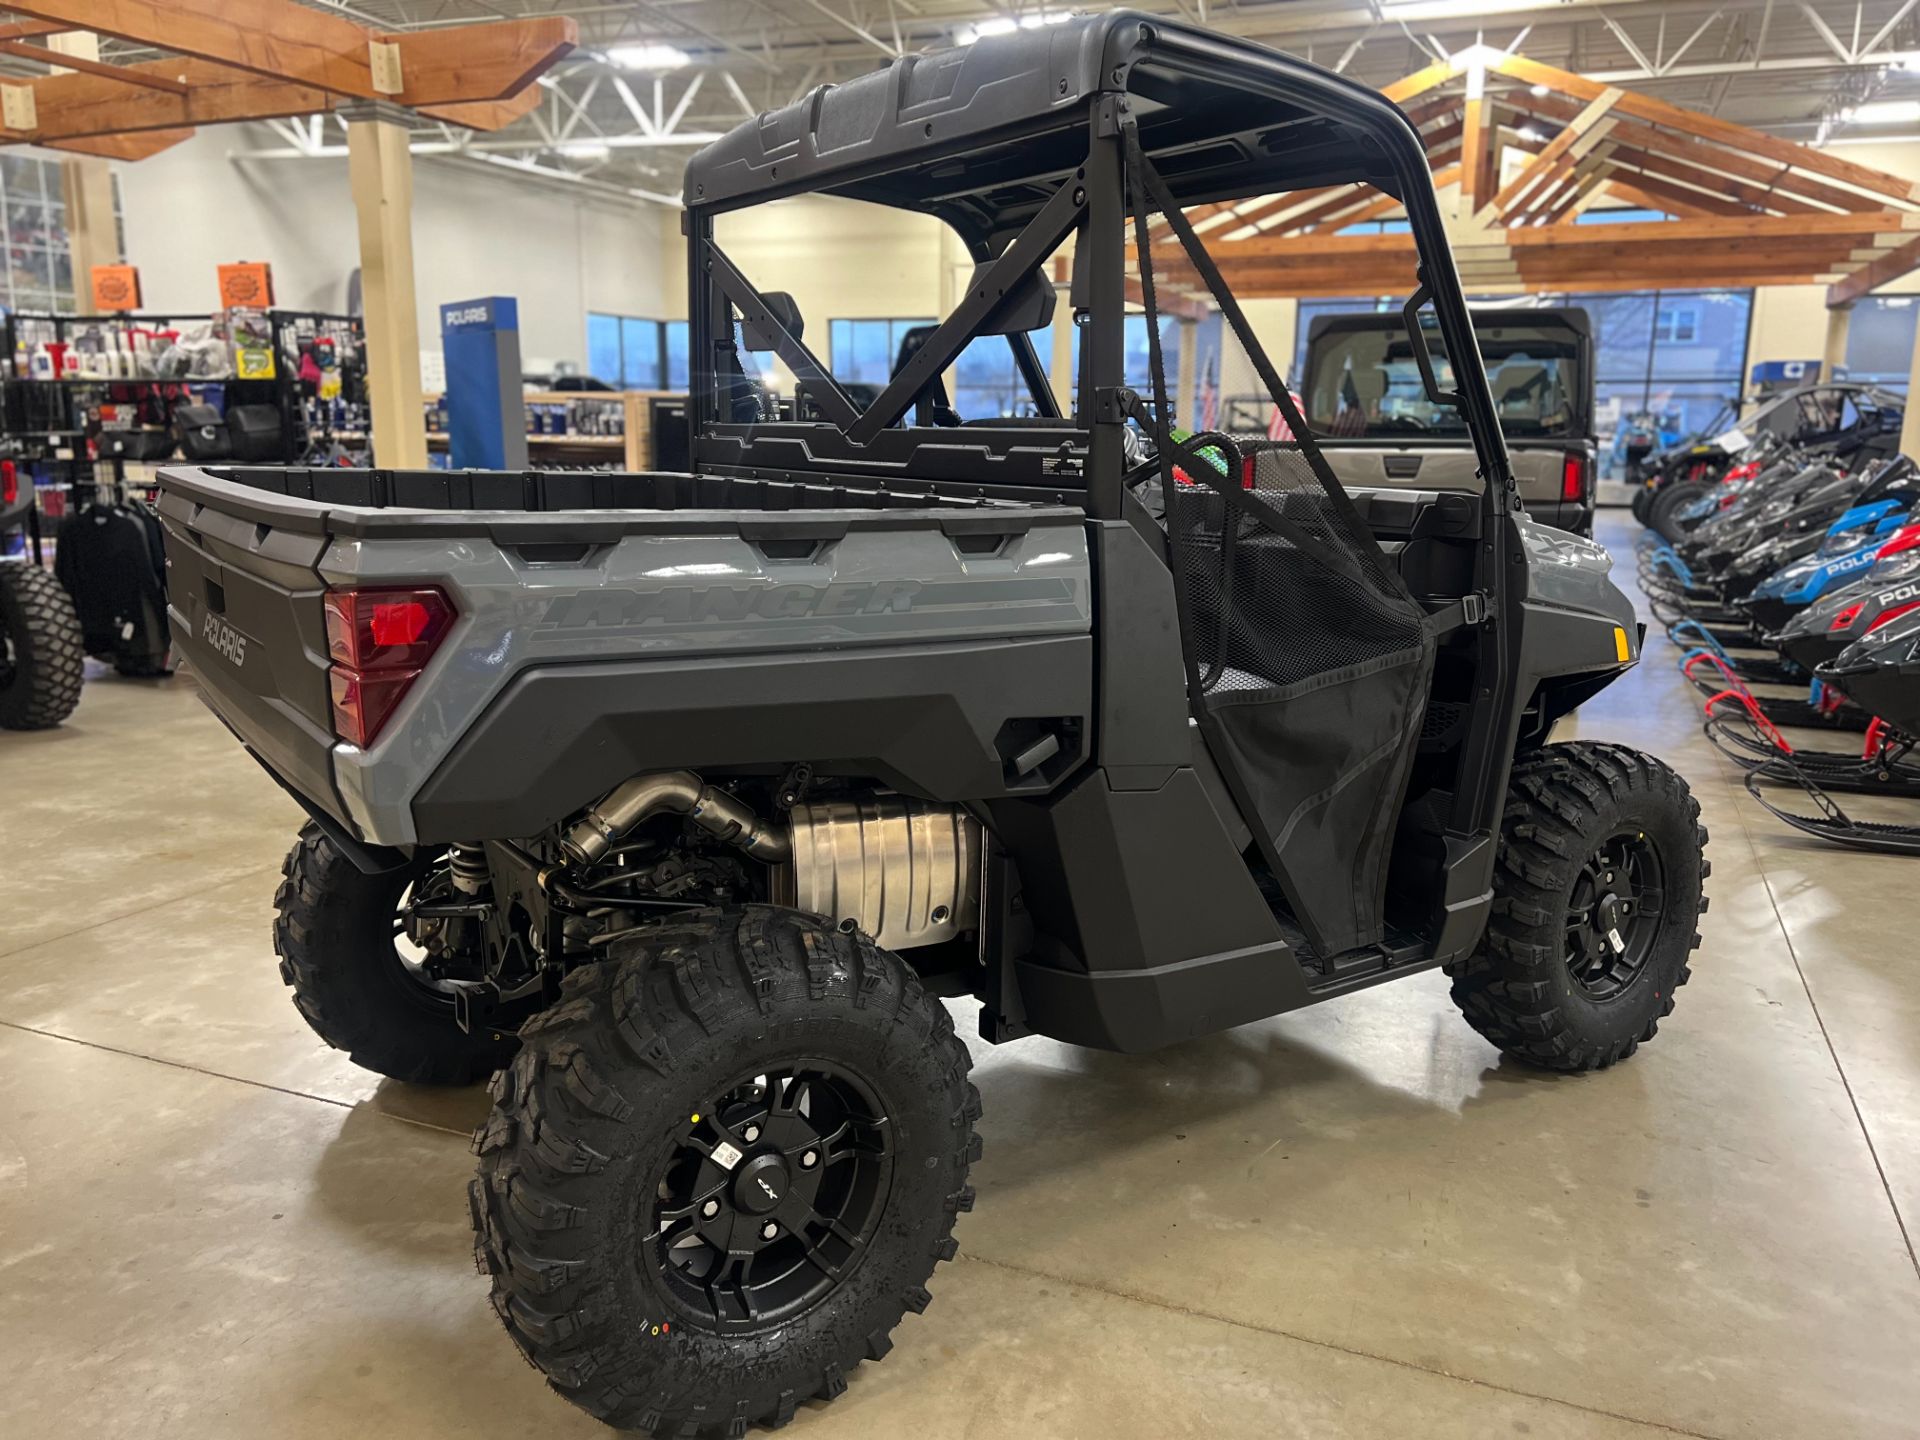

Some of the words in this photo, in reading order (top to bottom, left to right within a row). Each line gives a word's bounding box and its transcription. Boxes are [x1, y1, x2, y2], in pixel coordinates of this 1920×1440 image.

[1826, 551, 1877, 576] POLA
[557, 581, 922, 628] RANGER
[203, 612, 247, 667] POLARIS
